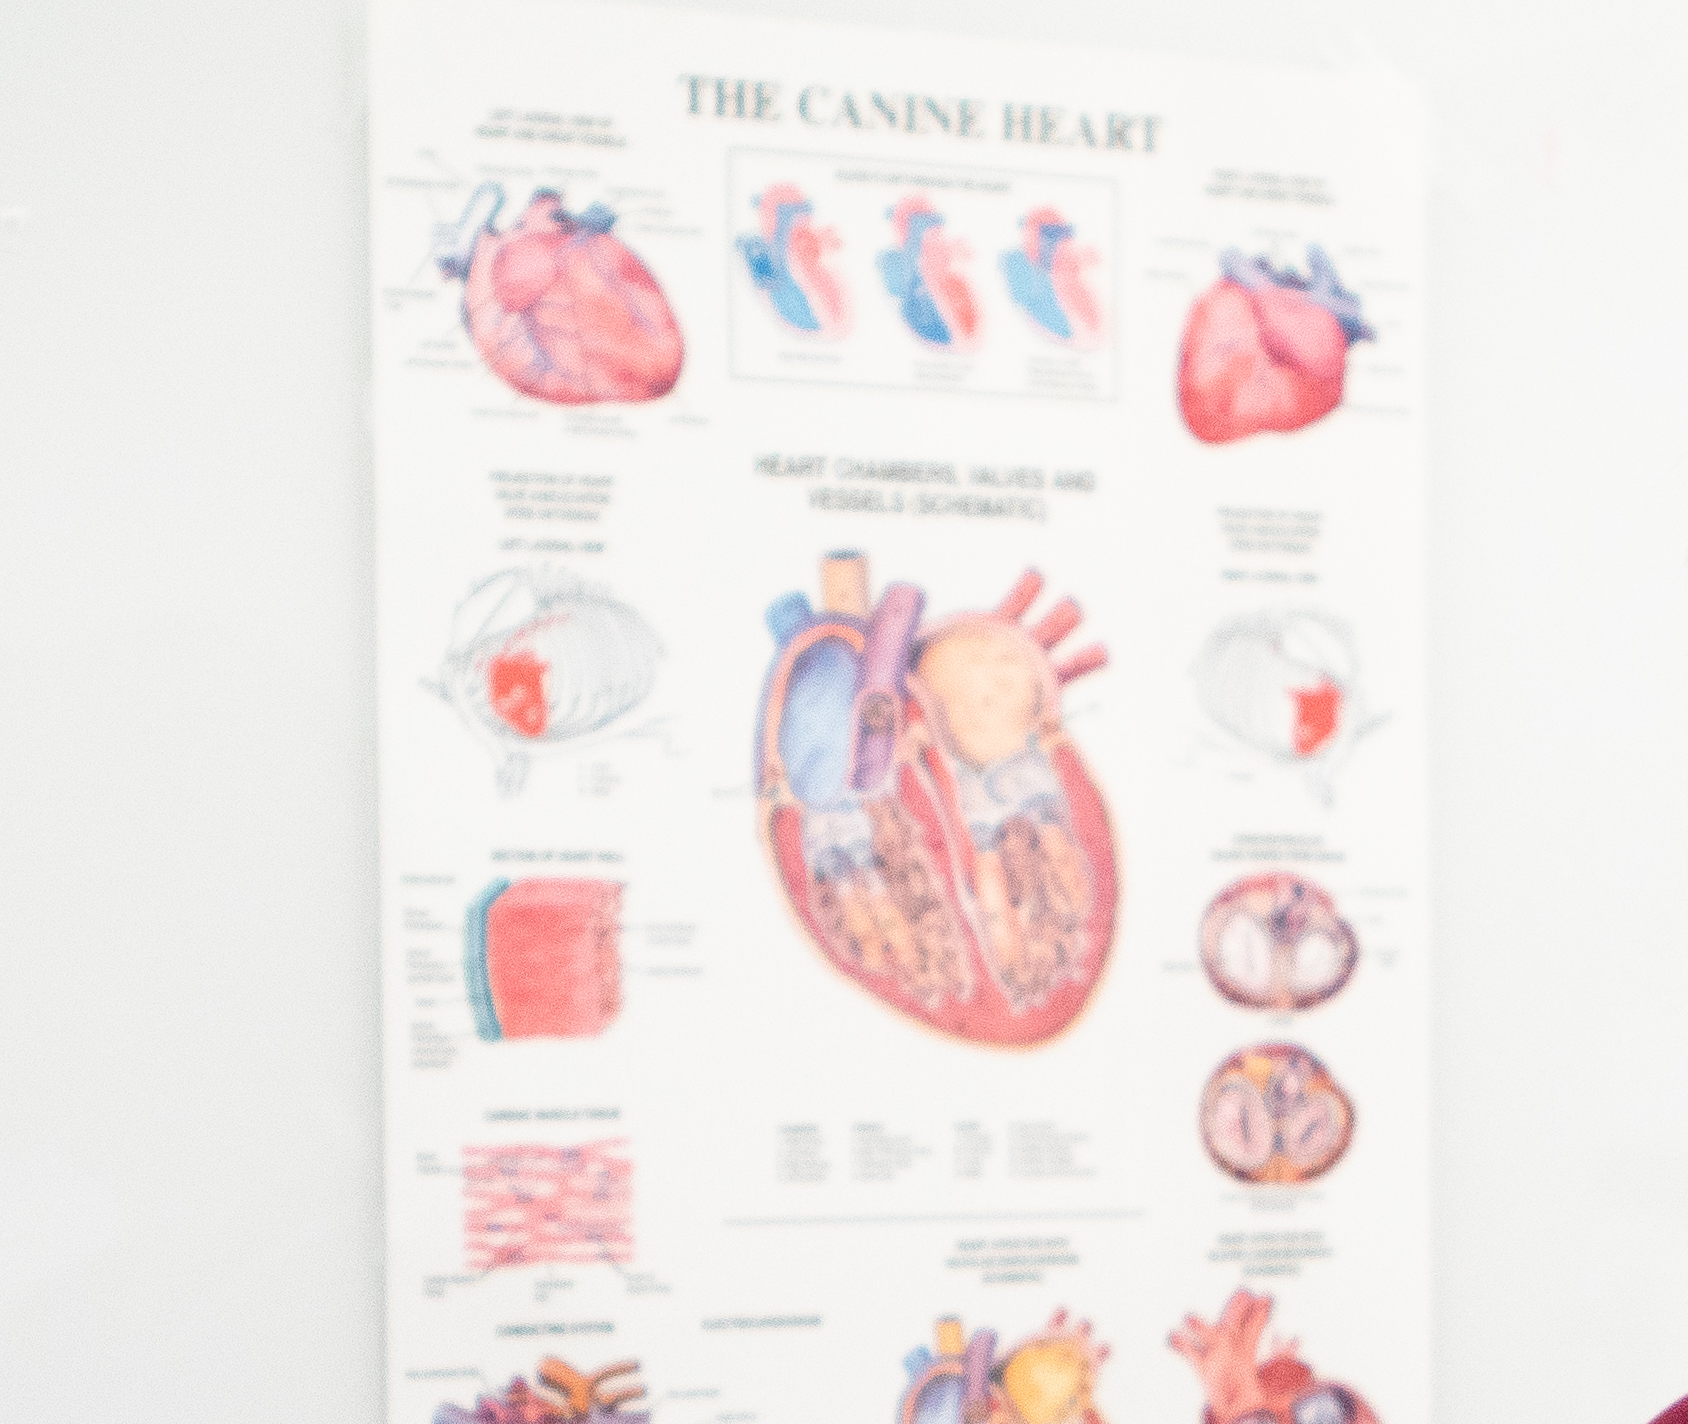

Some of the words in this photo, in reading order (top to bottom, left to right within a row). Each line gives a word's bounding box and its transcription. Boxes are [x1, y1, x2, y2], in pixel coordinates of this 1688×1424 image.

[679, 73, 780, 122] THE
[796, 82, 985, 140] CANINE
[1001, 100, 1164, 154] HEART
